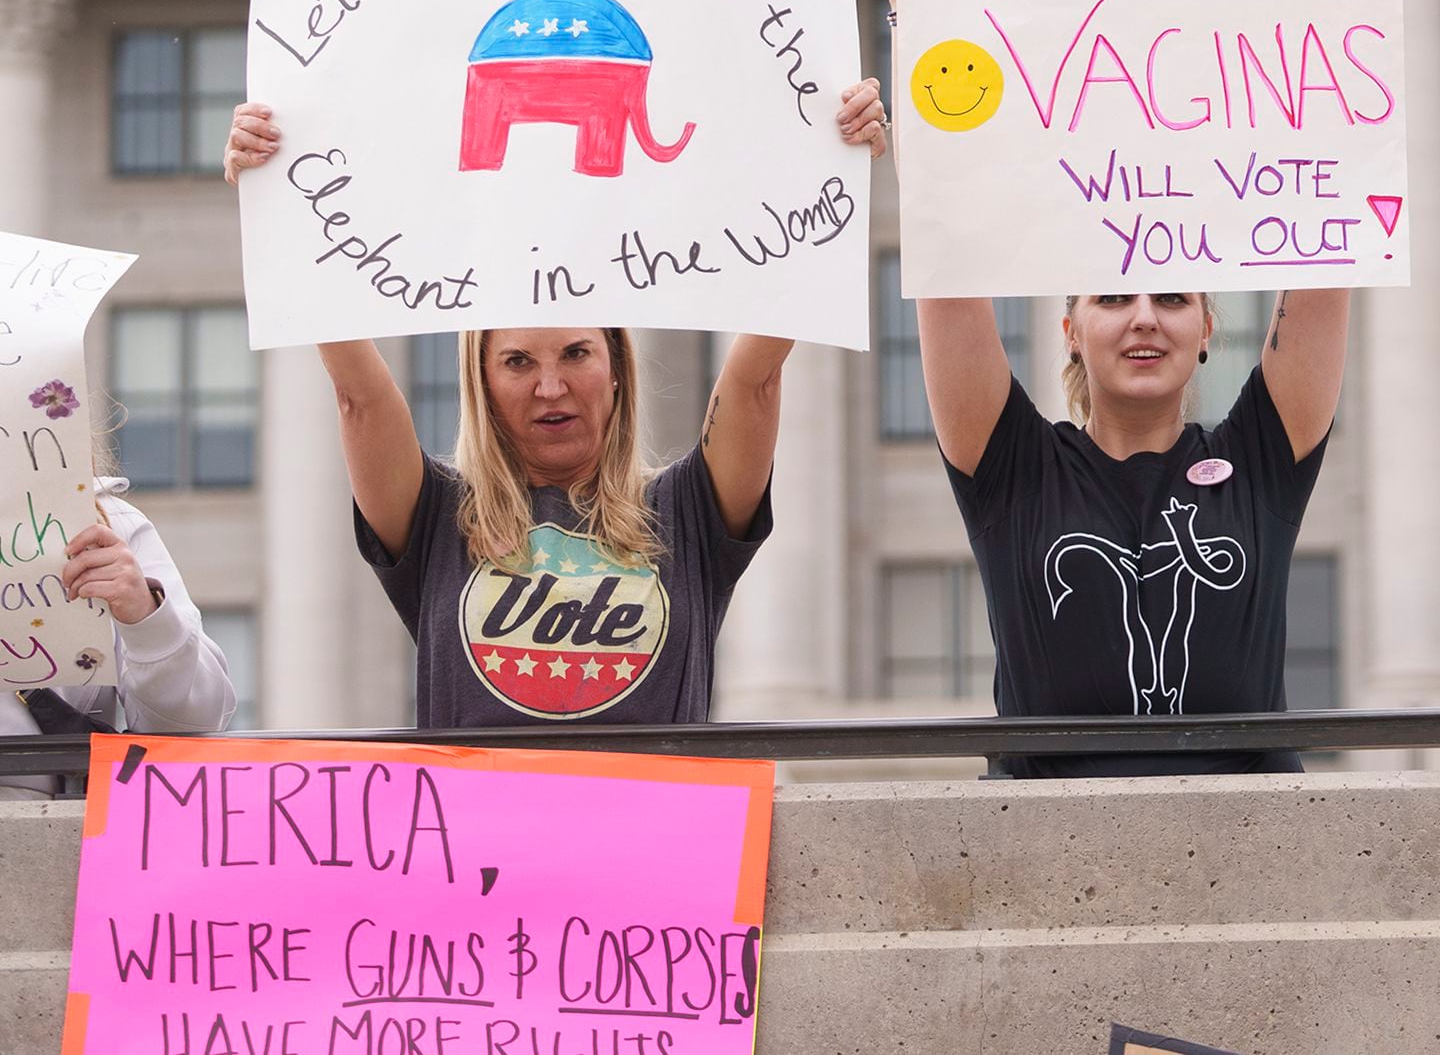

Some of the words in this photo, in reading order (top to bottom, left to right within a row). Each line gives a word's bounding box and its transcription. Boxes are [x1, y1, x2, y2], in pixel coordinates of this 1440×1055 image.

[760, 4, 820, 126] the
[1059, 149, 1194, 203] WILL
[1214, 152, 1340, 200] VOTE
[287, 148, 479, 310] Elephant
[532, 247, 595, 304] in
[611, 231, 721, 290] the
[1102, 213, 1222, 276] YOU
[480, 568, 648, 646] Vote
[109, 913, 311, 992] WHERE
[343, 918, 486, 999] GUNS
[558, 917, 761, 1024] CORPSES
